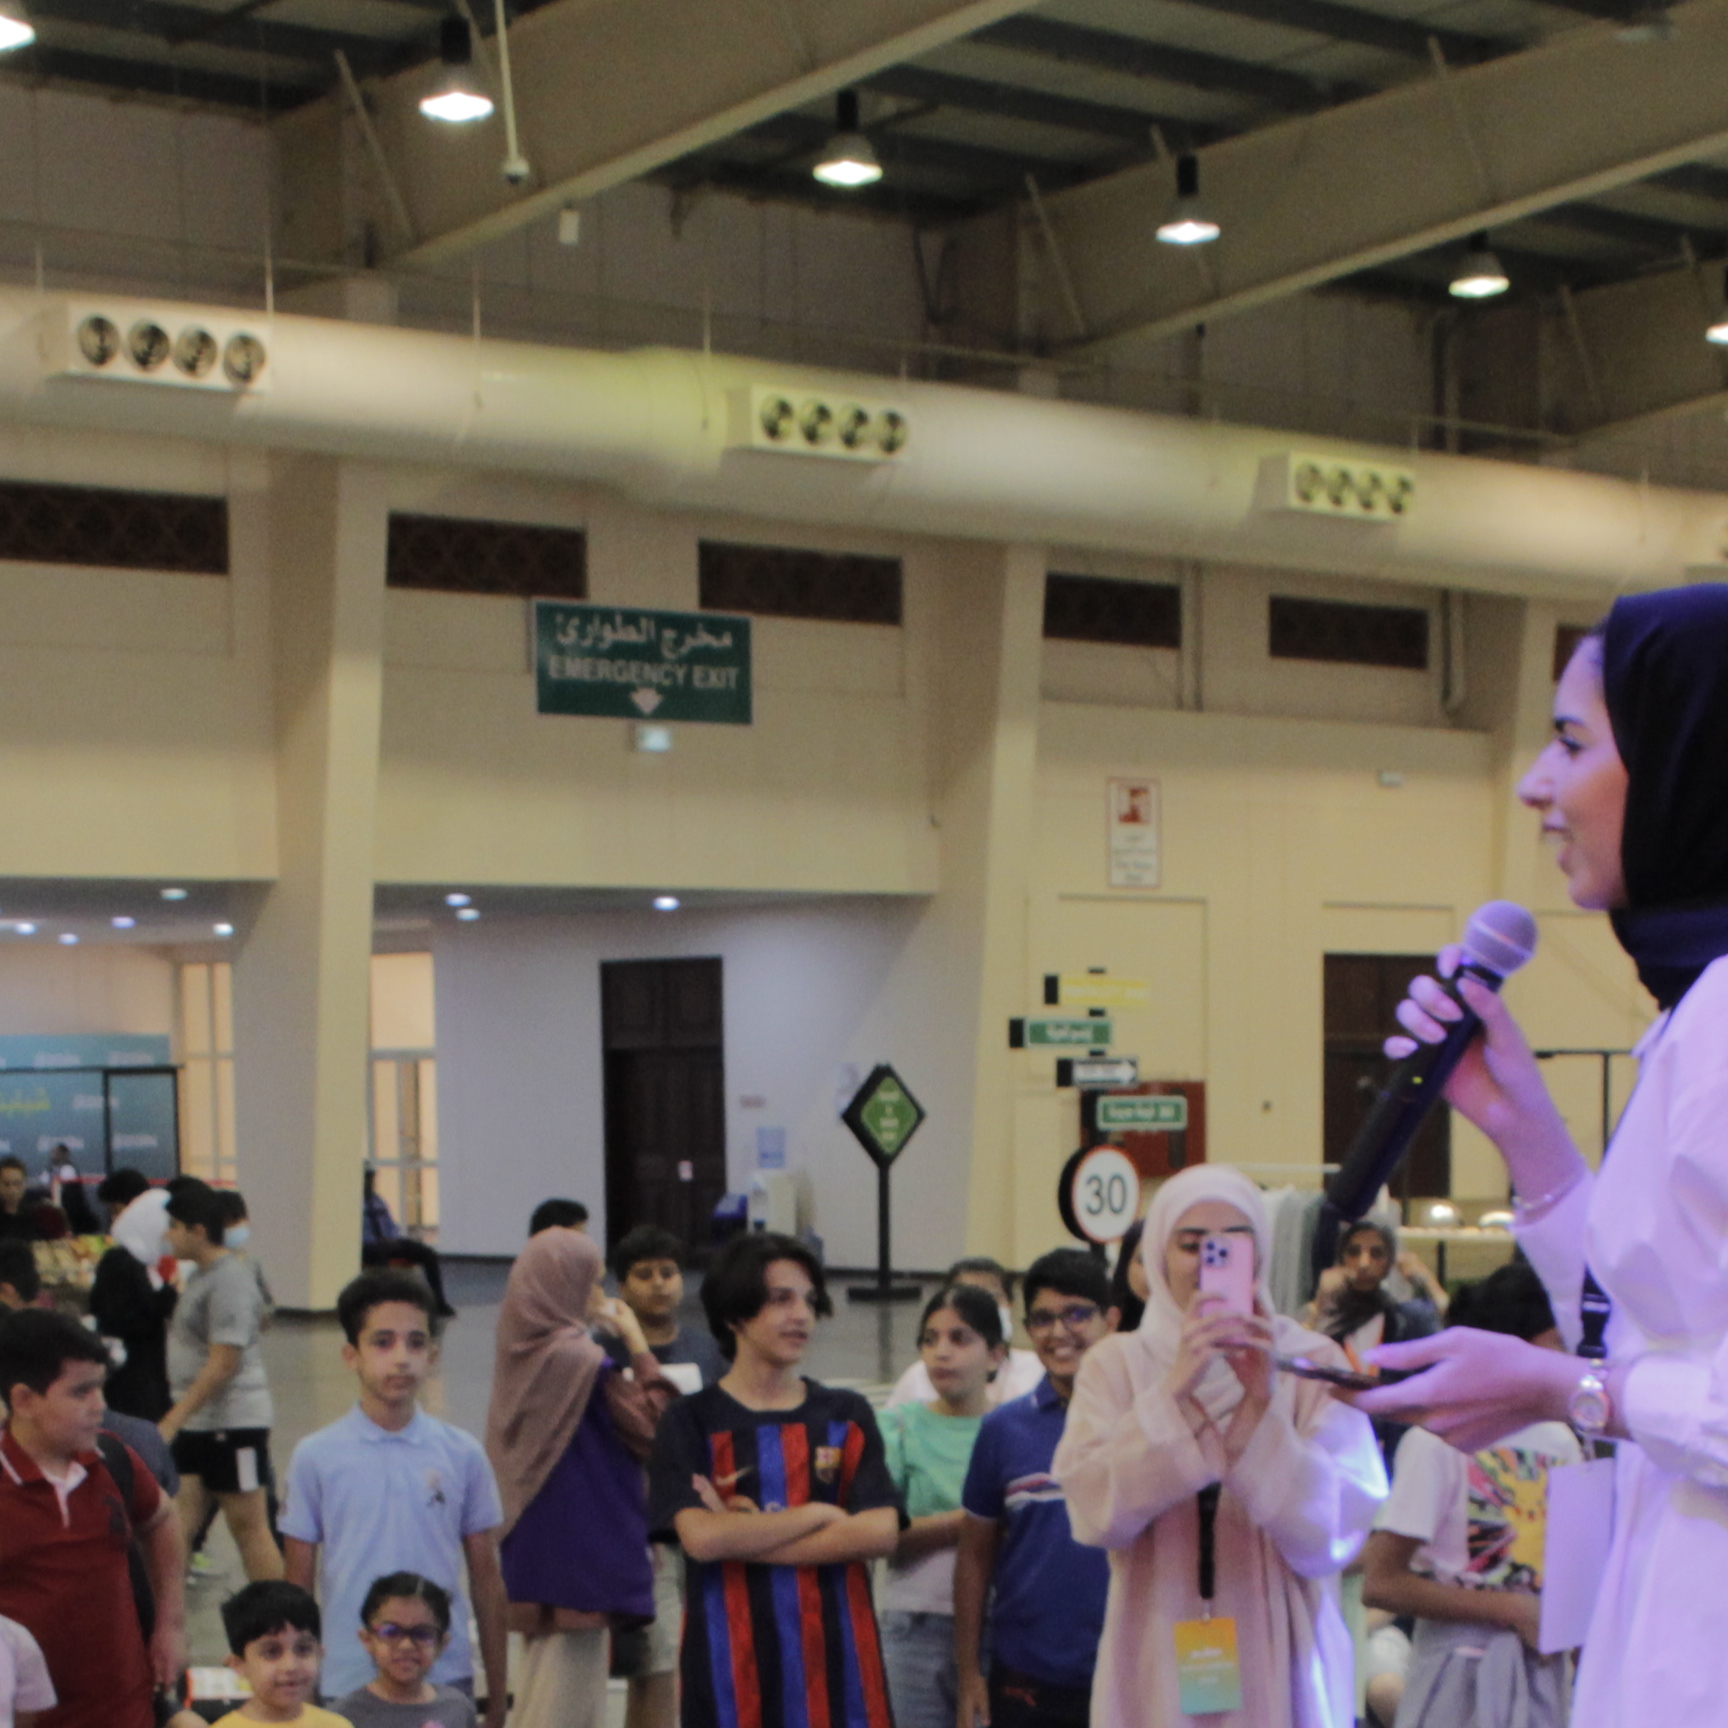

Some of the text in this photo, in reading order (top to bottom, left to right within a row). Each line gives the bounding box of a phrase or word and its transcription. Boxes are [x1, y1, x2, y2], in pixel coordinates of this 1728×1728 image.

[555, 611, 733, 660] مخرج الطوارئ
[549, 654, 739, 690] EMERGENCY EXIT
[1085, 1173, 1127, 1215] 30
